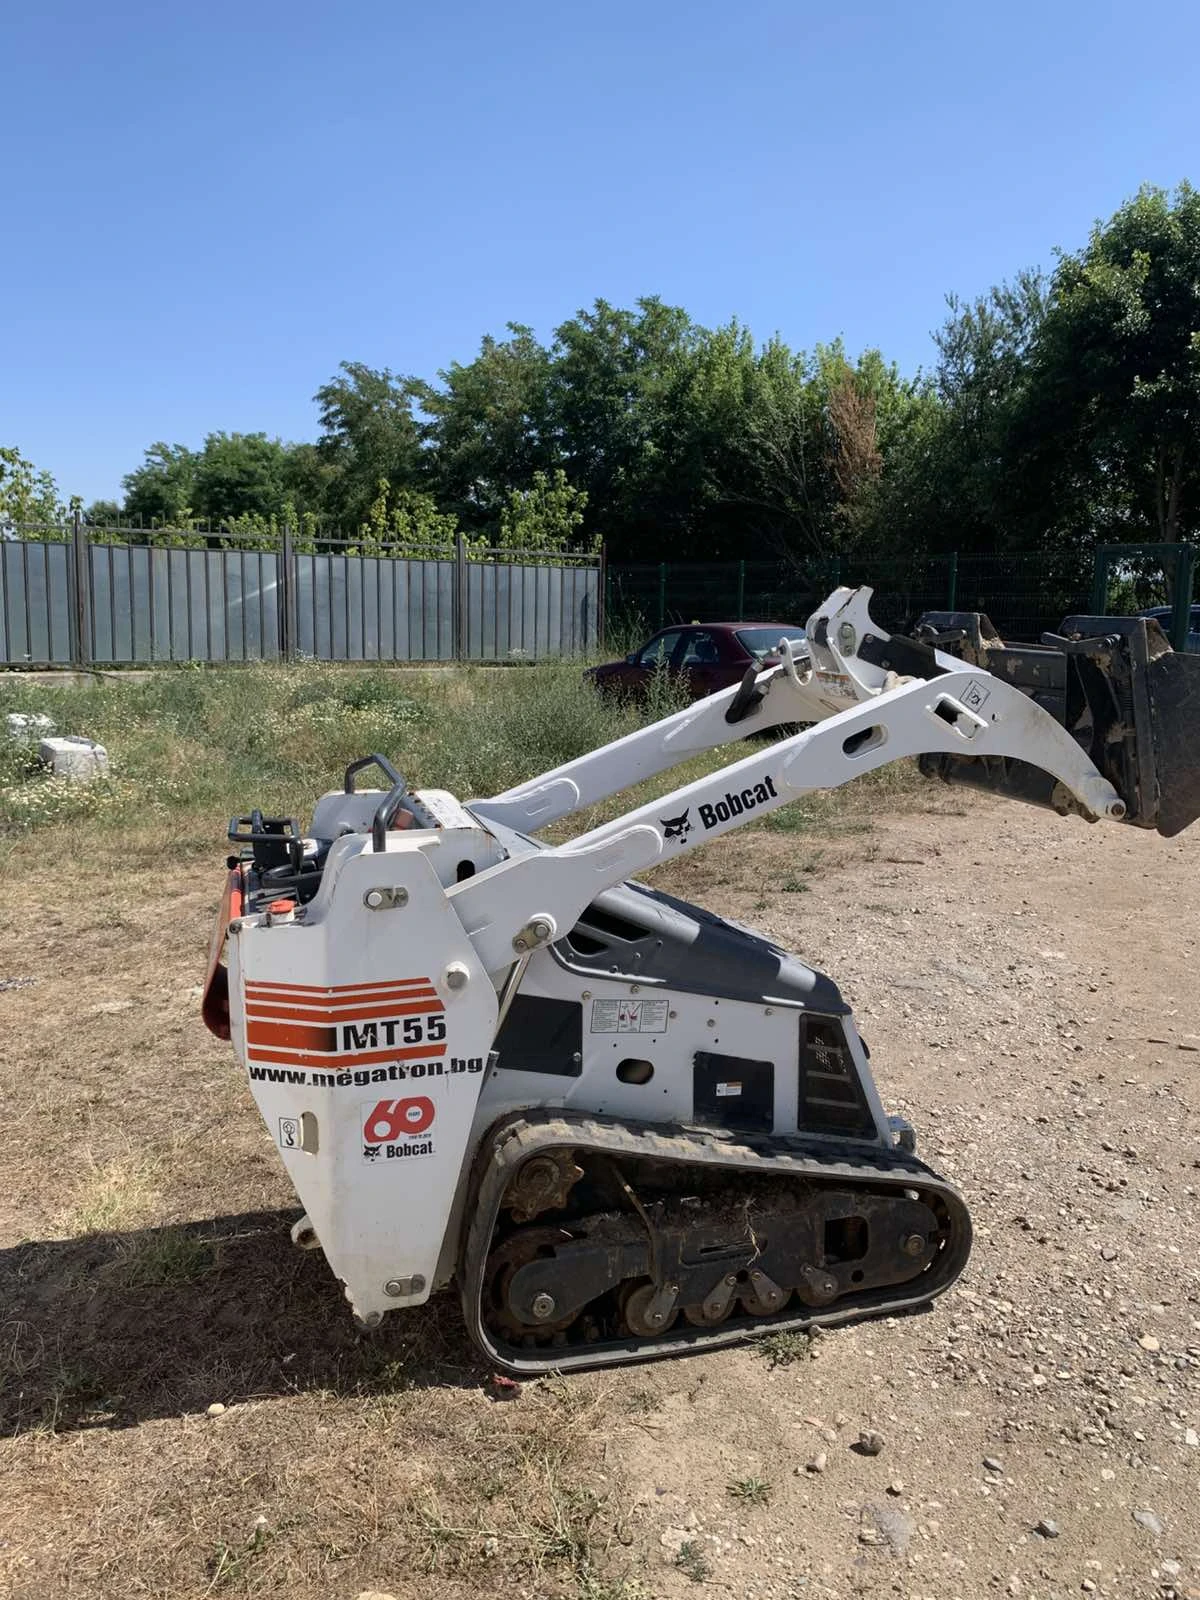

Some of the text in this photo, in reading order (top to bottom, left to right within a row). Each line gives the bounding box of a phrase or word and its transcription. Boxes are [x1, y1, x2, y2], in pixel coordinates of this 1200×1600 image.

[698, 775, 778, 830] Bobcat
[343, 1014, 447, 1051] MT55
[249, 1057, 483, 1087] www.megatron.bg
[363, 1095, 436, 1144] 60
[386, 1140, 433, 1159] Bobcat
